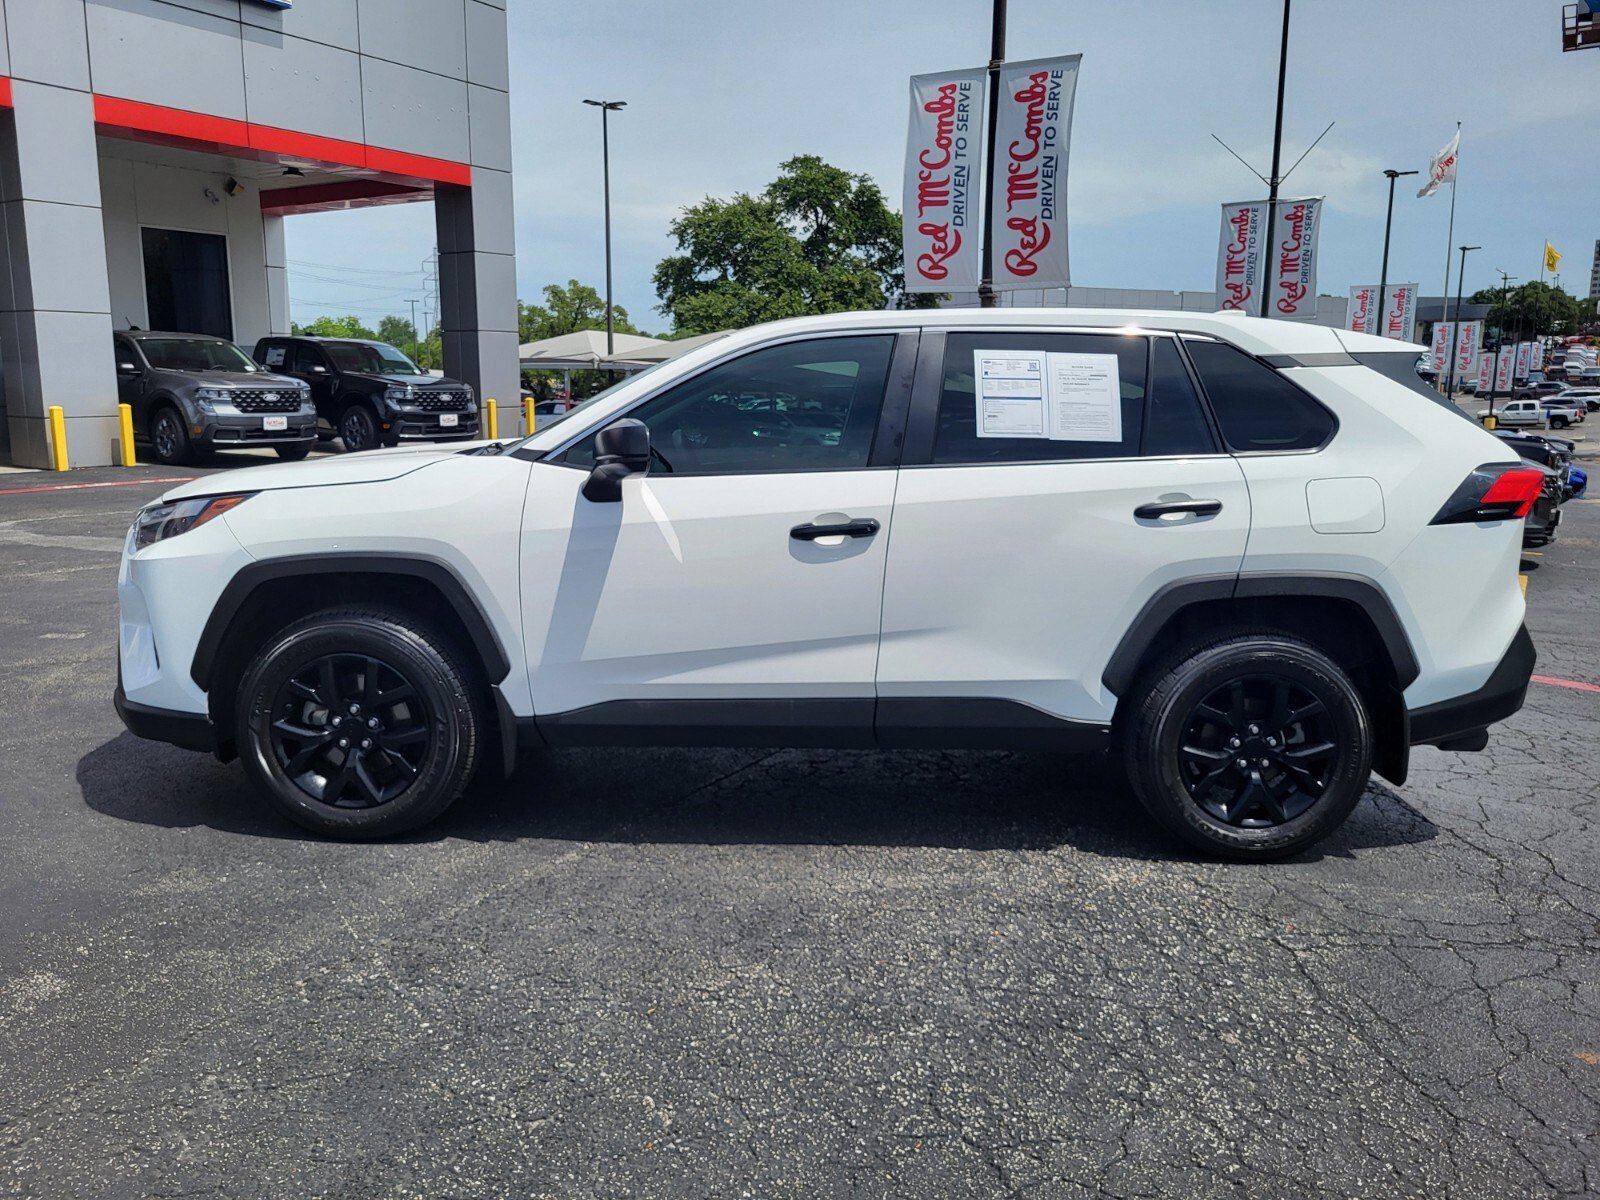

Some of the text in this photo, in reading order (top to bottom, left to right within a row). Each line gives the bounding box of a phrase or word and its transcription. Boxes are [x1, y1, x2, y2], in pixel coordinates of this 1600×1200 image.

[917, 83, 961, 280] Red McCombs
[953, 82, 971, 227] DRIVEN TO SERVE
[1005, 71, 1051, 277] Red McCombs
[1041, 70, 1063, 220] DRIVEN TO SERVE
[1222, 208, 1251, 310] Red McCombs
[1246, 207, 1259, 286] DRIVEN TO SERVE
[1277, 204, 1306, 314] Red McCombs
[1301, 204, 1314, 283] DRIVEN TO SERVE
